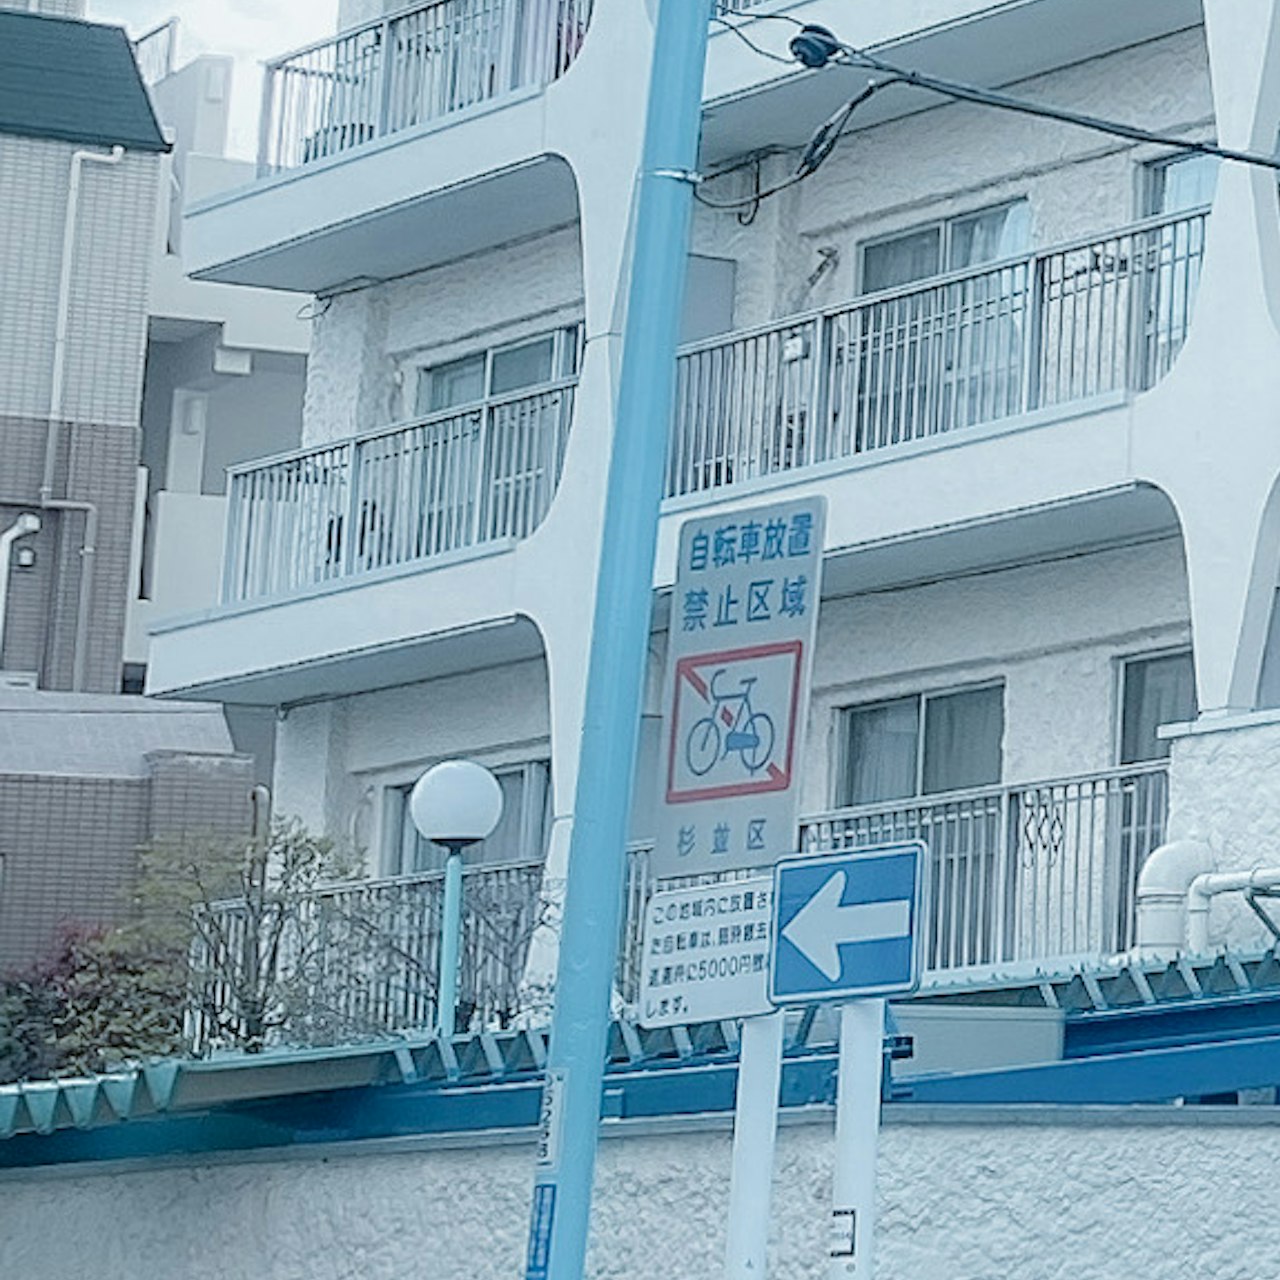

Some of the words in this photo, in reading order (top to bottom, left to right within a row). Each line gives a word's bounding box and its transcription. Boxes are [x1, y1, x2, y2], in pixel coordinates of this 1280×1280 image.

[690, 513, 813, 570] 自転車放置
[683, 575, 807, 631] 禁止区域
[677, 819, 767, 856] 杉並区
